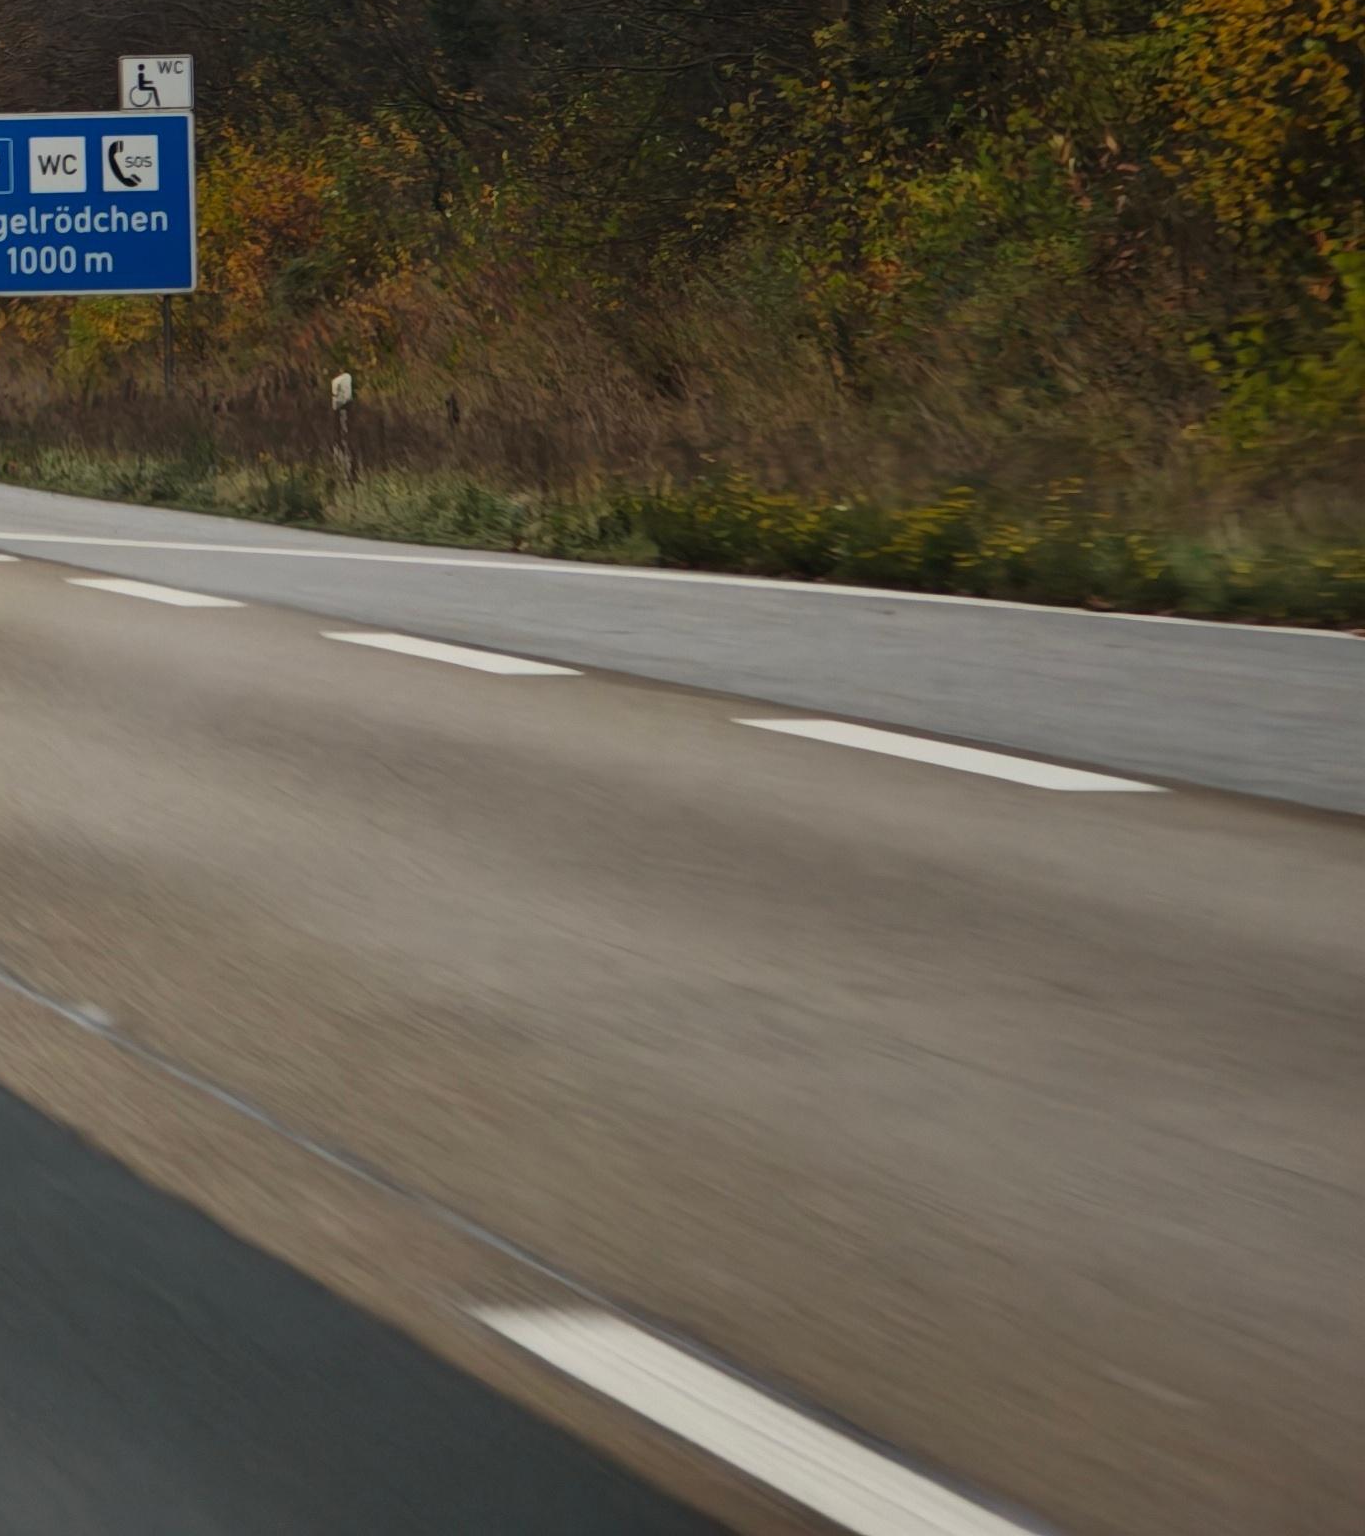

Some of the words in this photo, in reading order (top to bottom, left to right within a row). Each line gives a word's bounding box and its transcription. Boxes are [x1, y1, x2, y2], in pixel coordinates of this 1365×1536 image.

[157, 60, 184, 74] WC
[38, 154, 78, 175] WC
[124, 155, 153, 168] SOS
[7, 246, 77, 274] 1000
[85, 251, 113, 273] m
